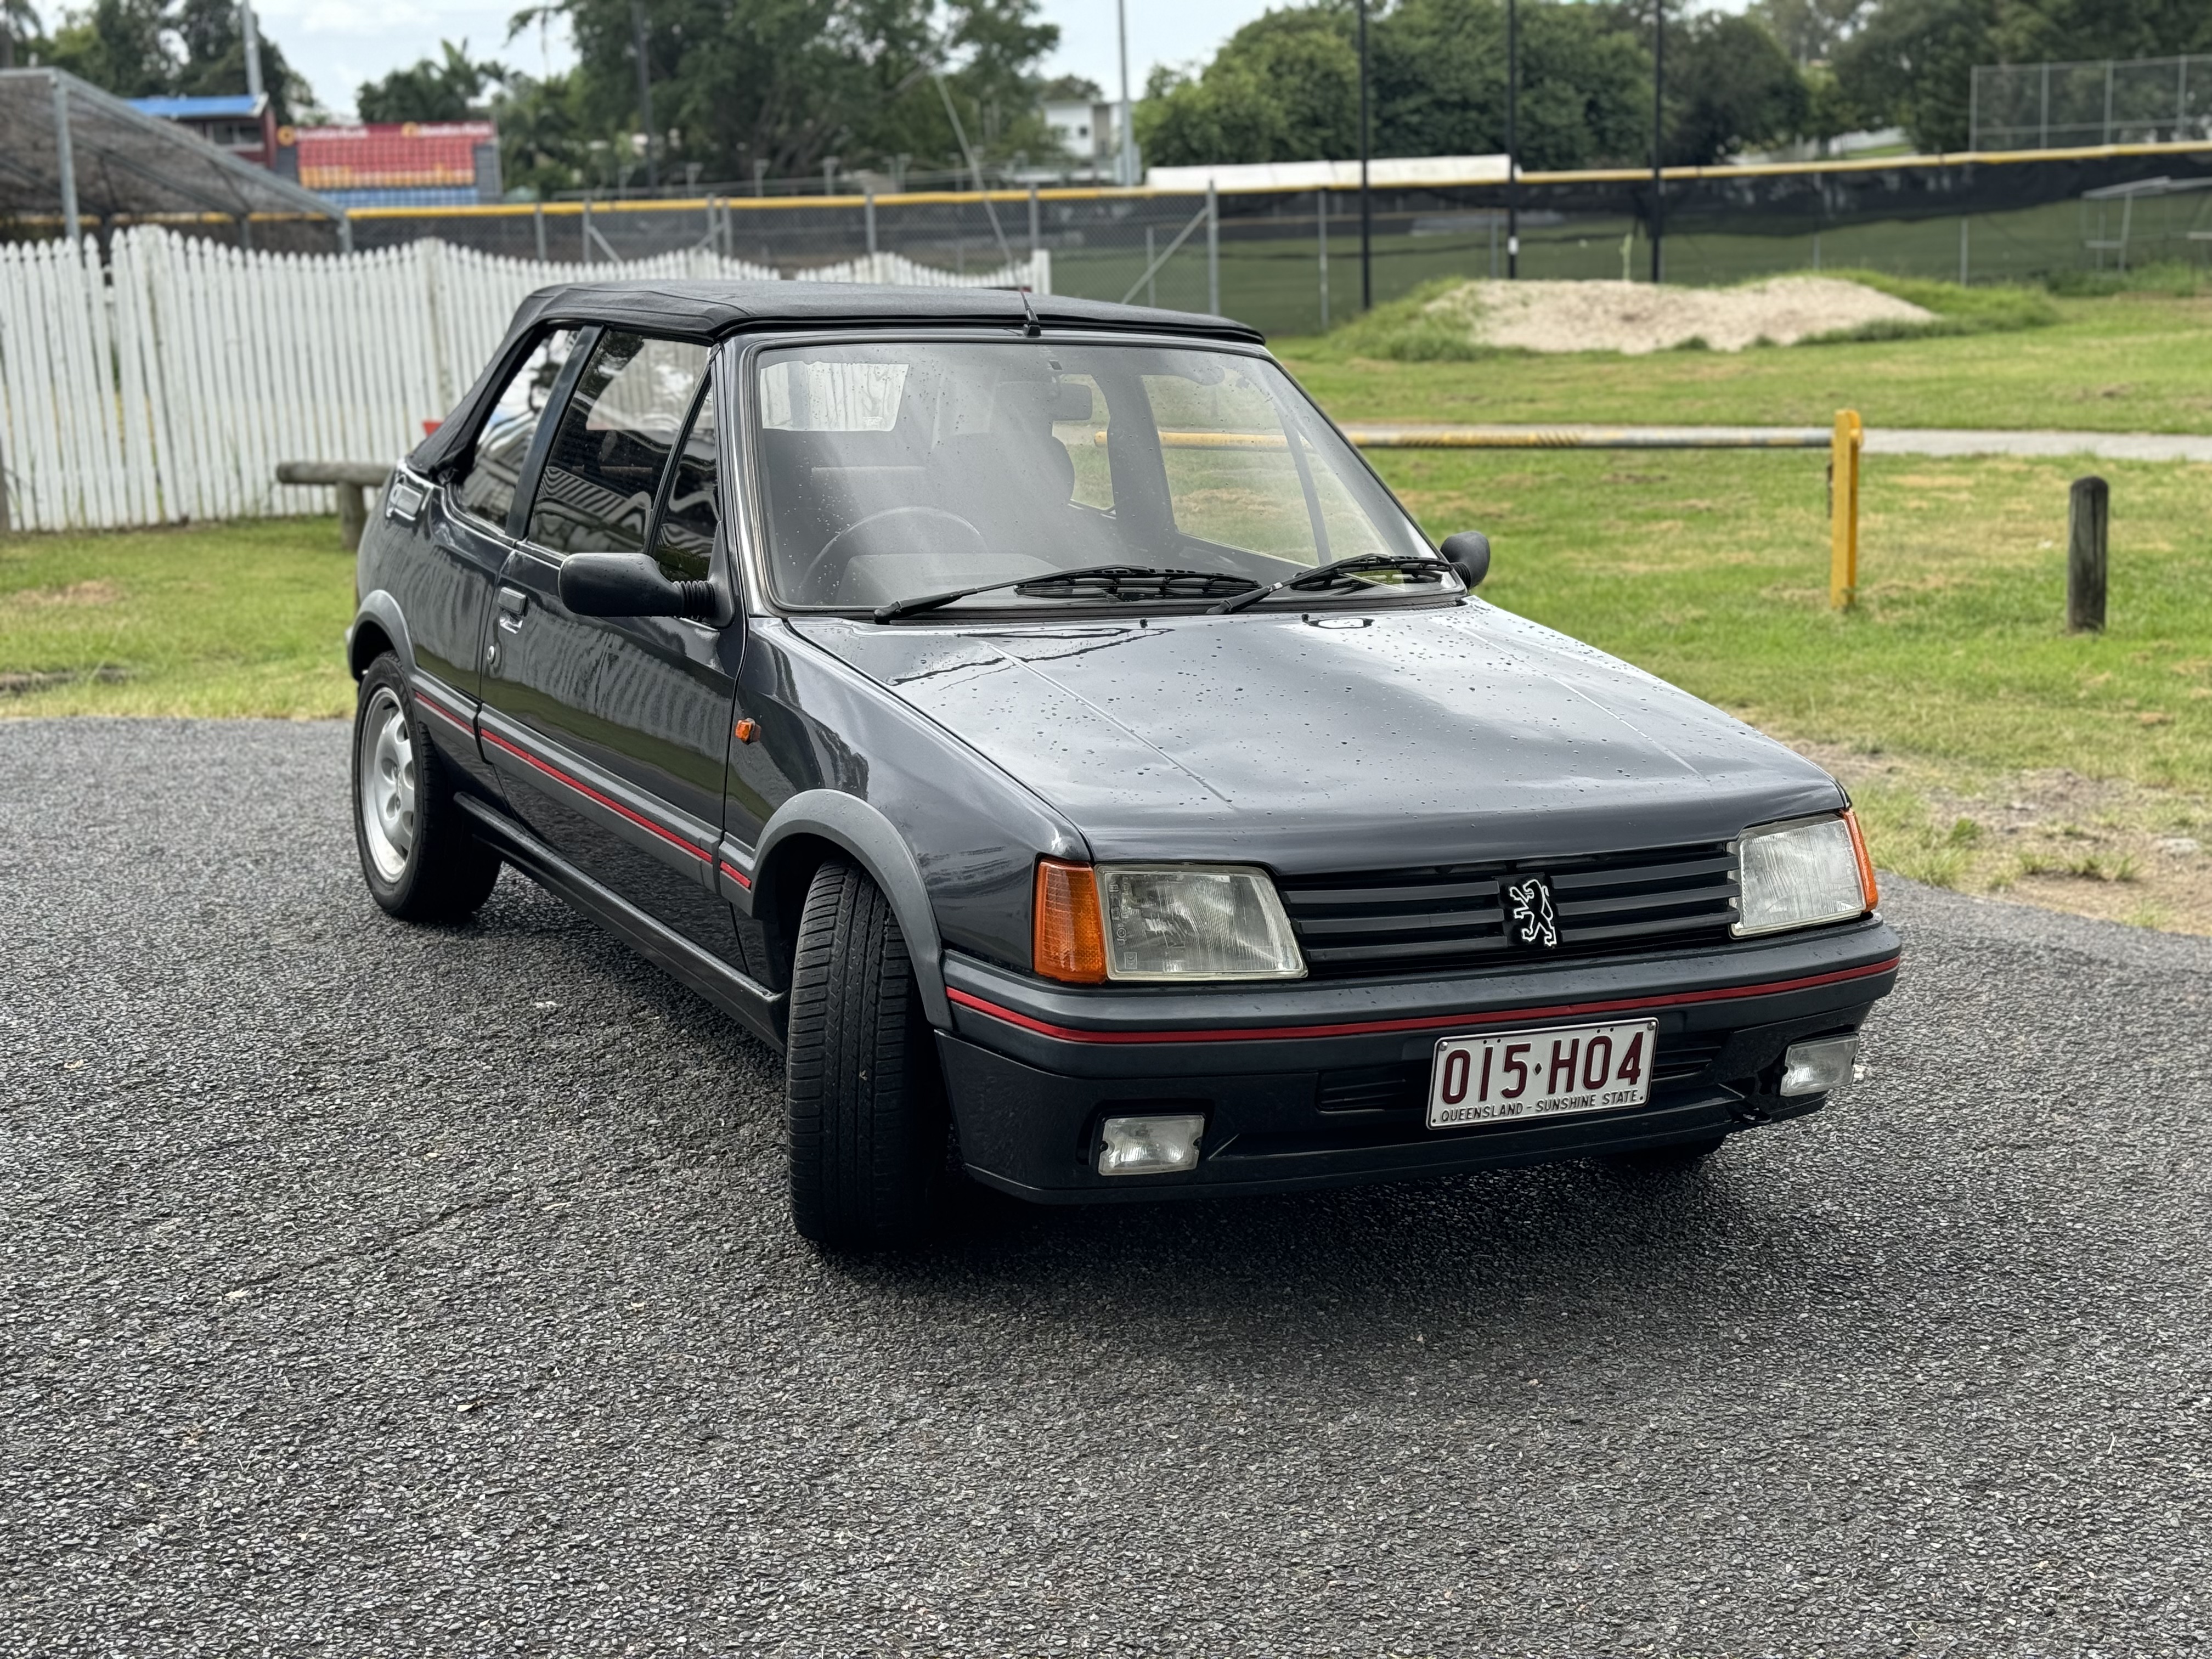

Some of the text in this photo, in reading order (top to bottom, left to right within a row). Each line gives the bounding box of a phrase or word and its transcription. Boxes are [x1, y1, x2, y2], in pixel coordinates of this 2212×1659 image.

[1441, 1104, 1523, 1122] QUEENSLAND
[1536, 1094, 1596, 1113] SUNSHINE
[1602, 1089, 1638, 1105] STATE
